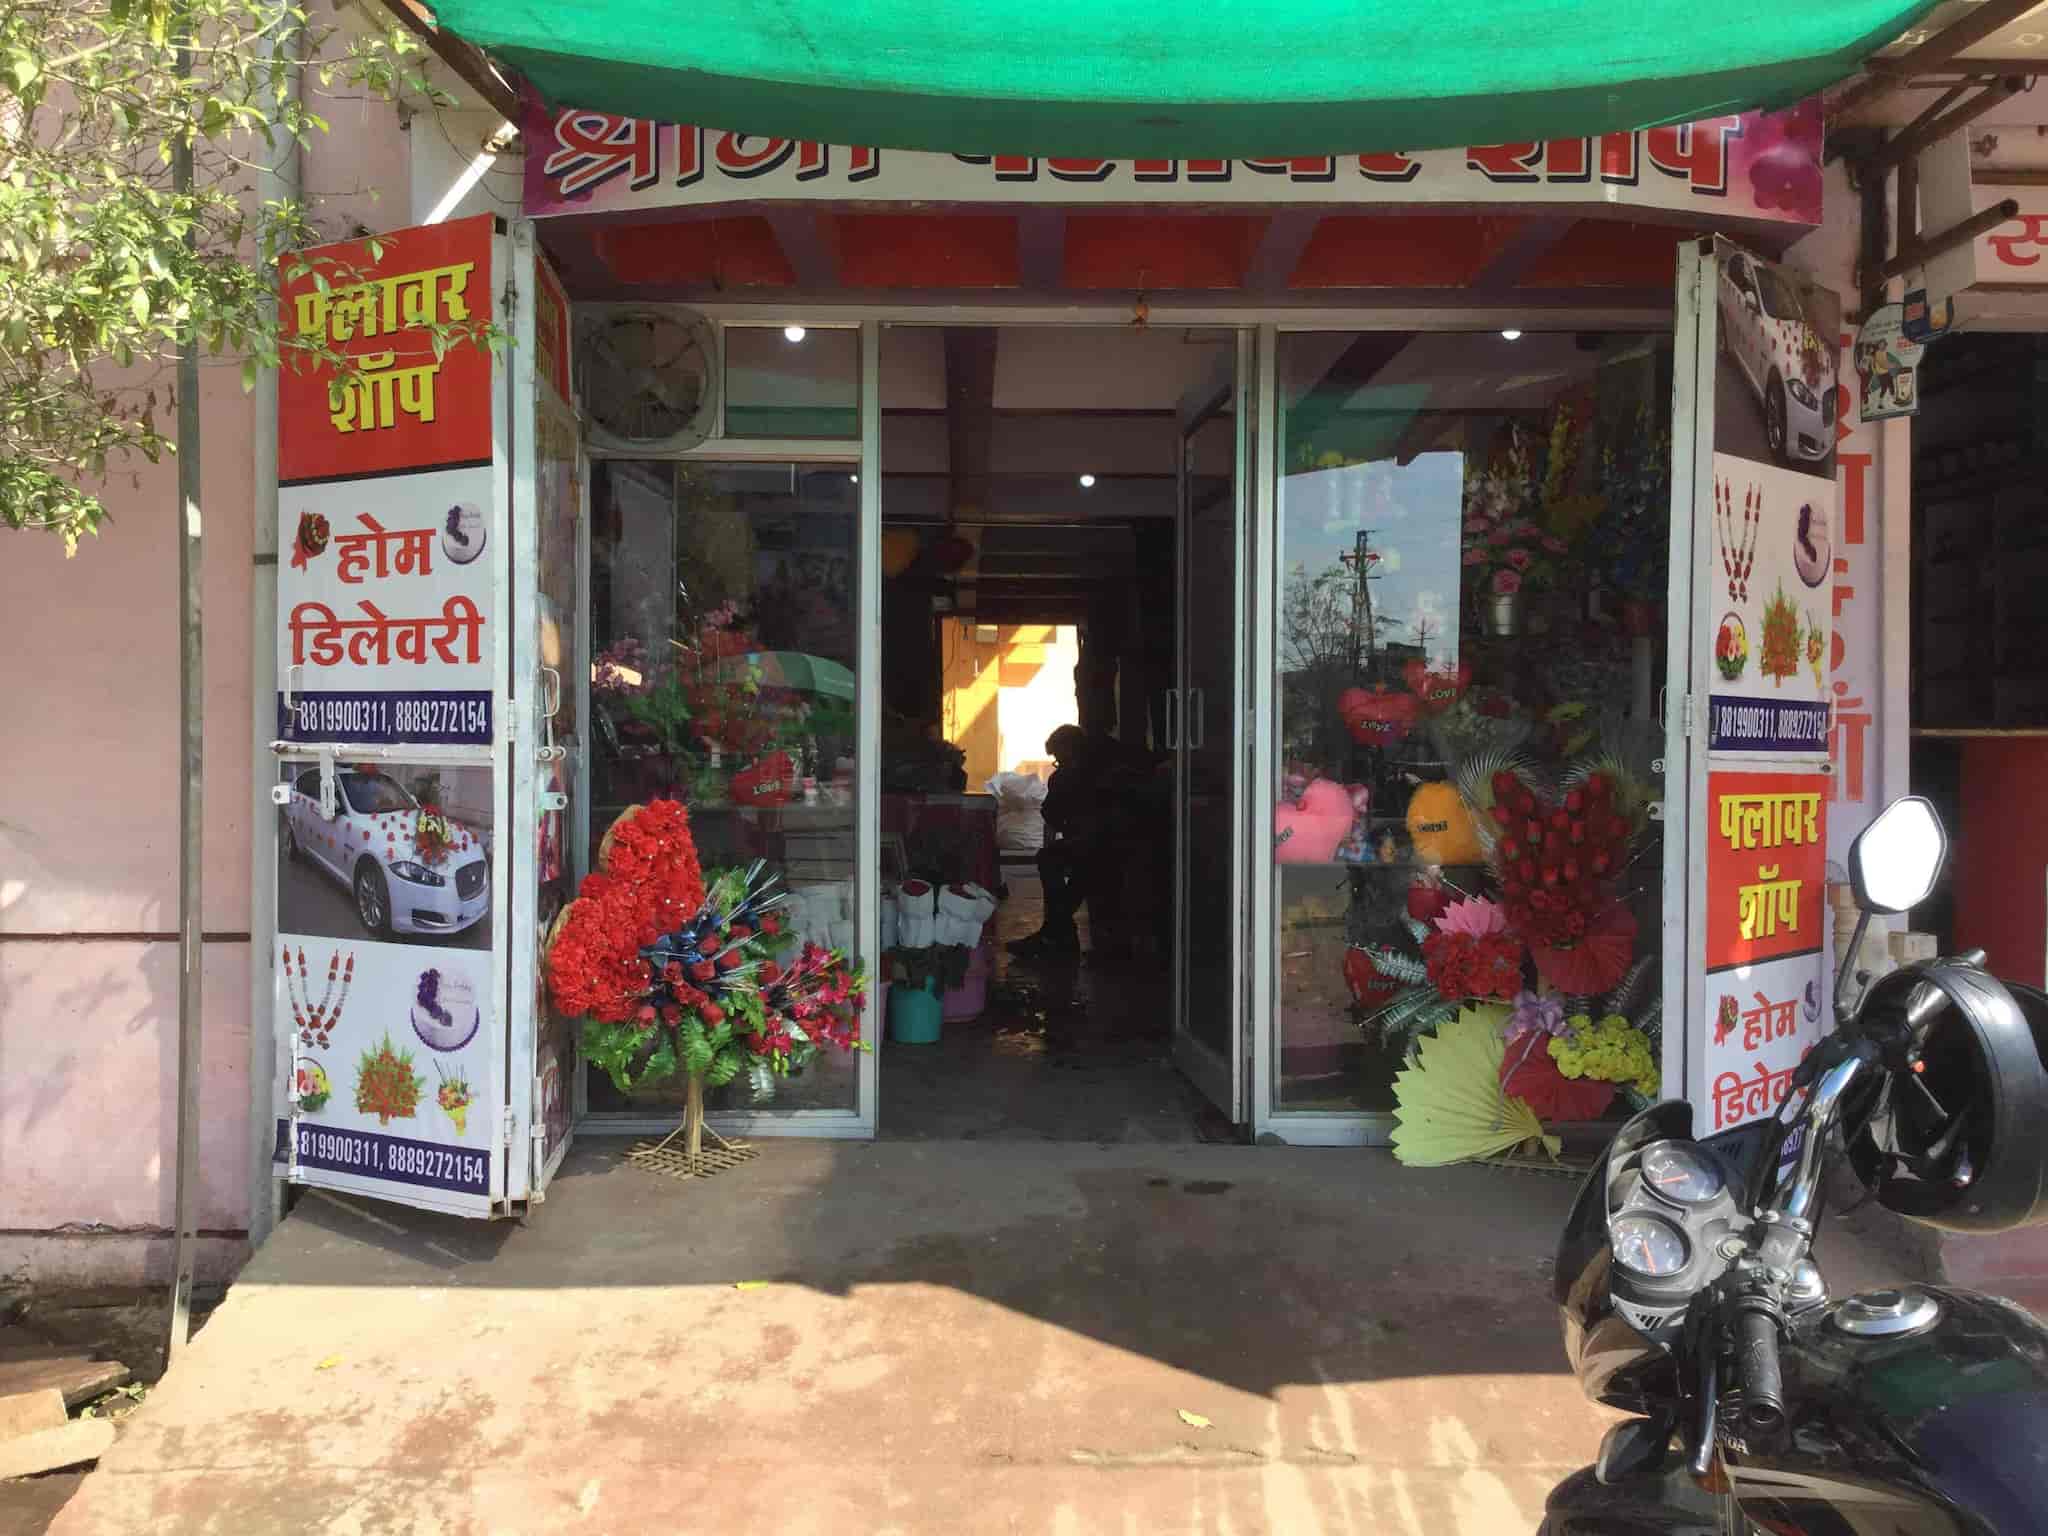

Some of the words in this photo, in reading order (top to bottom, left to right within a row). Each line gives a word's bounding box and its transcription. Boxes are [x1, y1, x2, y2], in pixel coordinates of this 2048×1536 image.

[327, 347, 441, 433] शॉप
[335, 512, 437, 583] होम
[288, 595, 485, 666] डिलेवरी
[300, 700, 391, 735] 8819900311,
[395, 700, 487, 733] 8889272154
[1720, 705, 1776, 742] 8819900311,
[1739, 863, 1803, 940] शॉप
[1741, 991, 1799, 1051] होम
[295, 1130, 384, 1171] 819900311,
[388, 1144, 484, 1184] 8889272154
